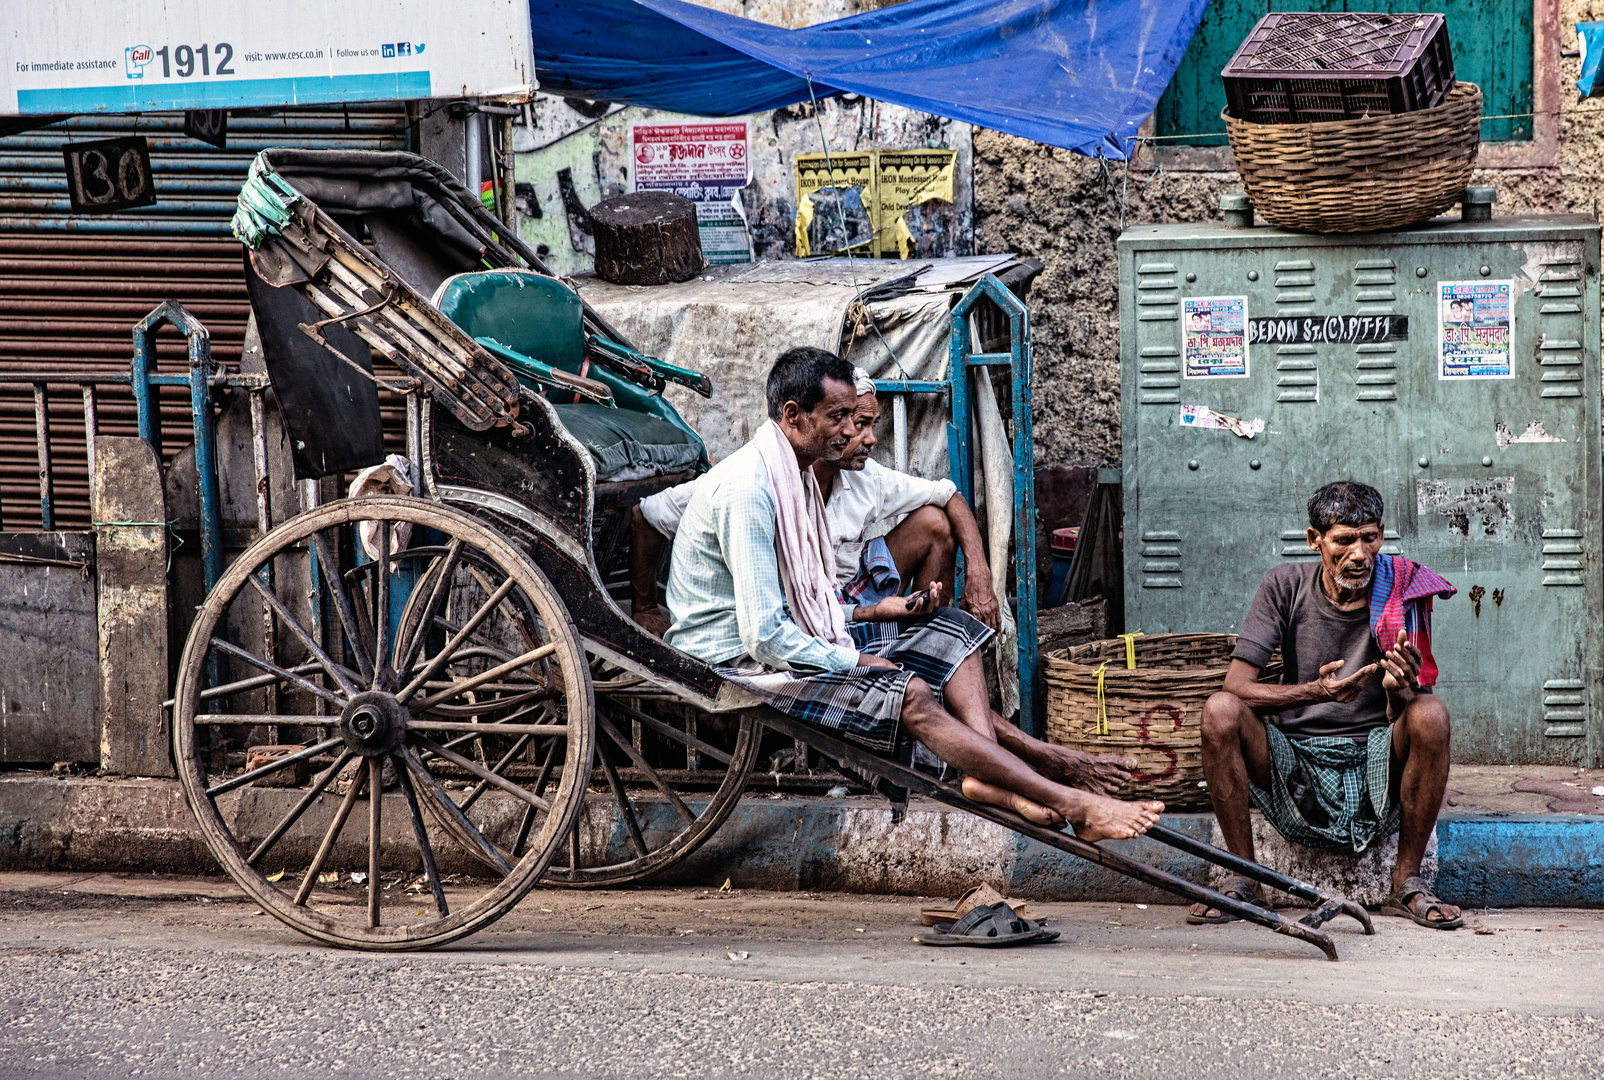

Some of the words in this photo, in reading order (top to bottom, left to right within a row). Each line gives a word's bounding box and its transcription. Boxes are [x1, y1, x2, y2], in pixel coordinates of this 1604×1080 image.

[132, 50, 150, 61] Call
[244, 52, 263, 62] visit:
[264, 49, 324, 61] www.cesc.co.in
[336, 48, 359, 58] Follow
[360, 49, 369, 57] us
[370, 48, 380, 56] on
[16, 62, 29, 72] For
[31, 60, 74, 71] immediate
[76, 58, 117, 70] assistance
[156, 43, 235, 78] 1912
[669, 143, 706, 162] রক্তদান
[881, 156, 901, 165] Admission
[902, 155, 914, 166] Going
[914, 156, 920, 164] On
[927, 155, 943, 165] Session
[801, 178, 816, 188] IKON
[881, 174, 897, 184] IKON
[895, 186, 910, 196] Play
[881, 203, 894, 211] Child
[1453, 286, 1474, 294] SEX
[1249, 319, 1298, 343] BEDON
[1474, 326, 1508, 346] मजुमदार
[1212, 335, 1243, 352] মজুমদার
